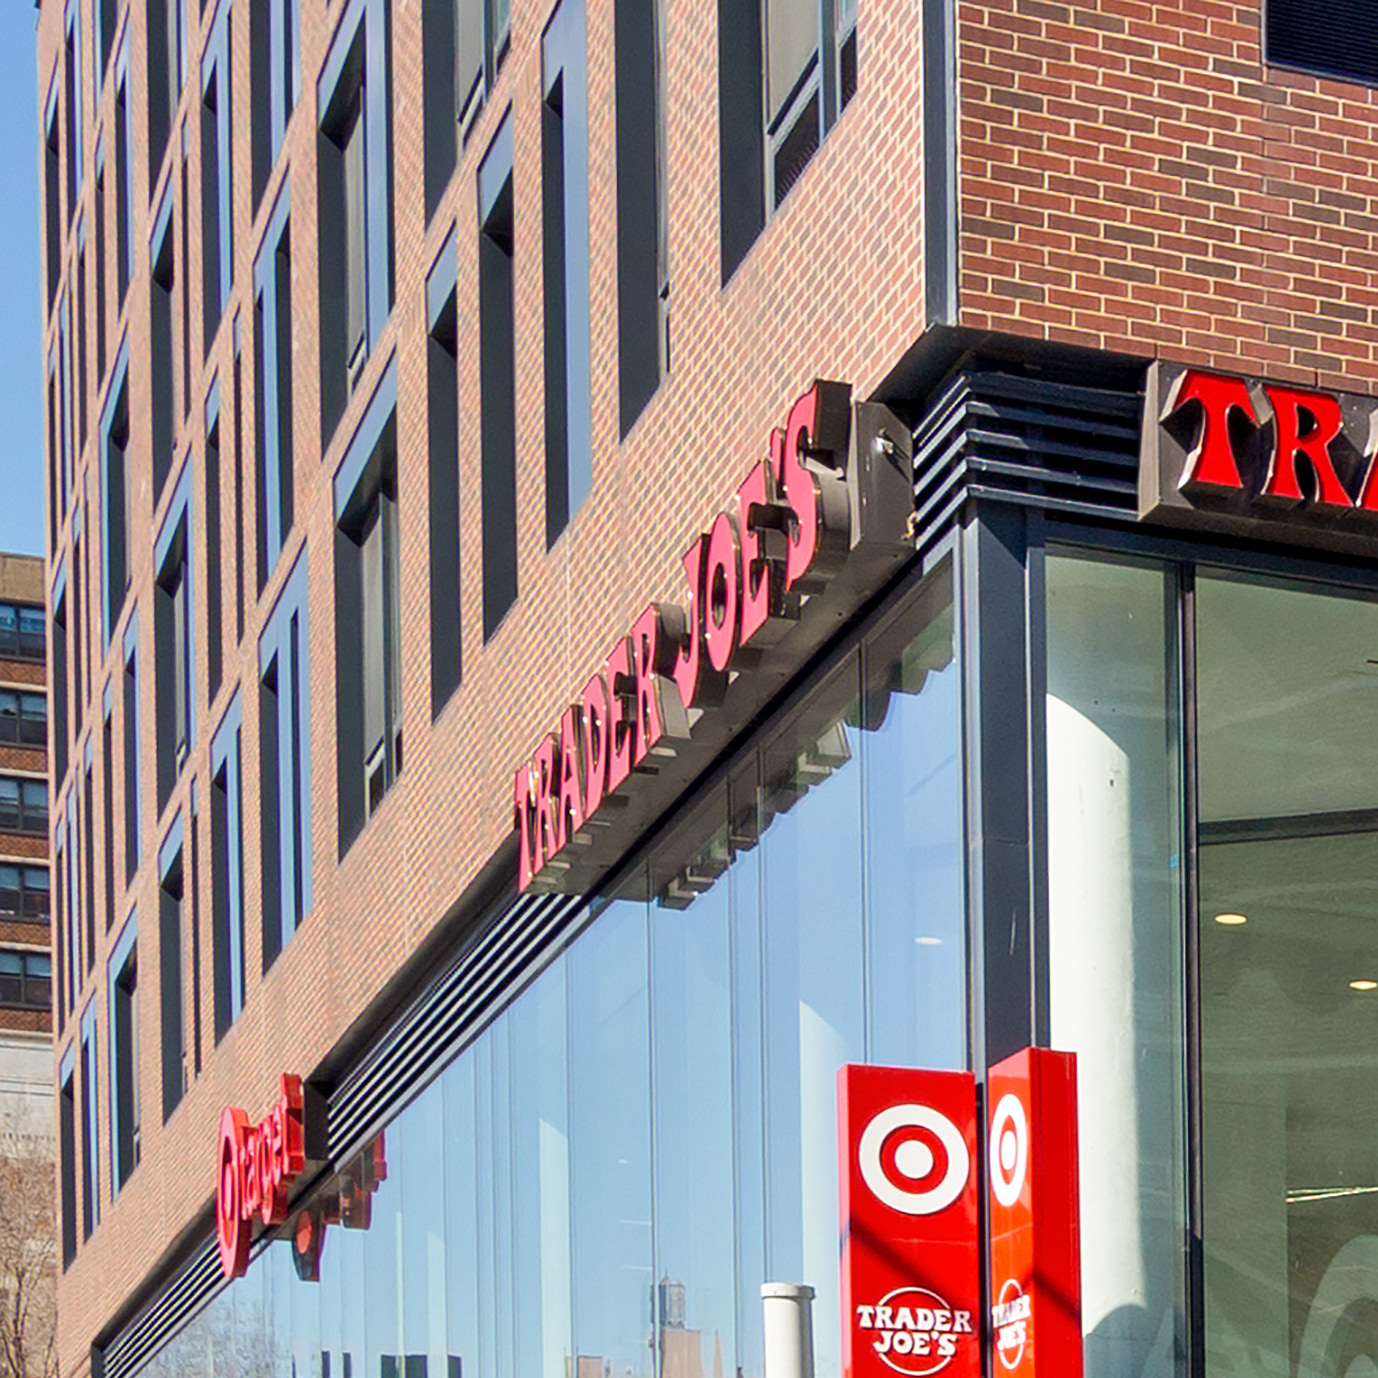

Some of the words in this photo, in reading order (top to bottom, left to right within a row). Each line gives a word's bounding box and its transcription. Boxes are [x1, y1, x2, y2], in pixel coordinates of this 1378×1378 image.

[515, 602, 665, 894] TRADER
[673, 384, 819, 709] JOE'S
[856, 1304, 973, 1333] TRADER
[872, 1330, 958, 1357] JOE'S
